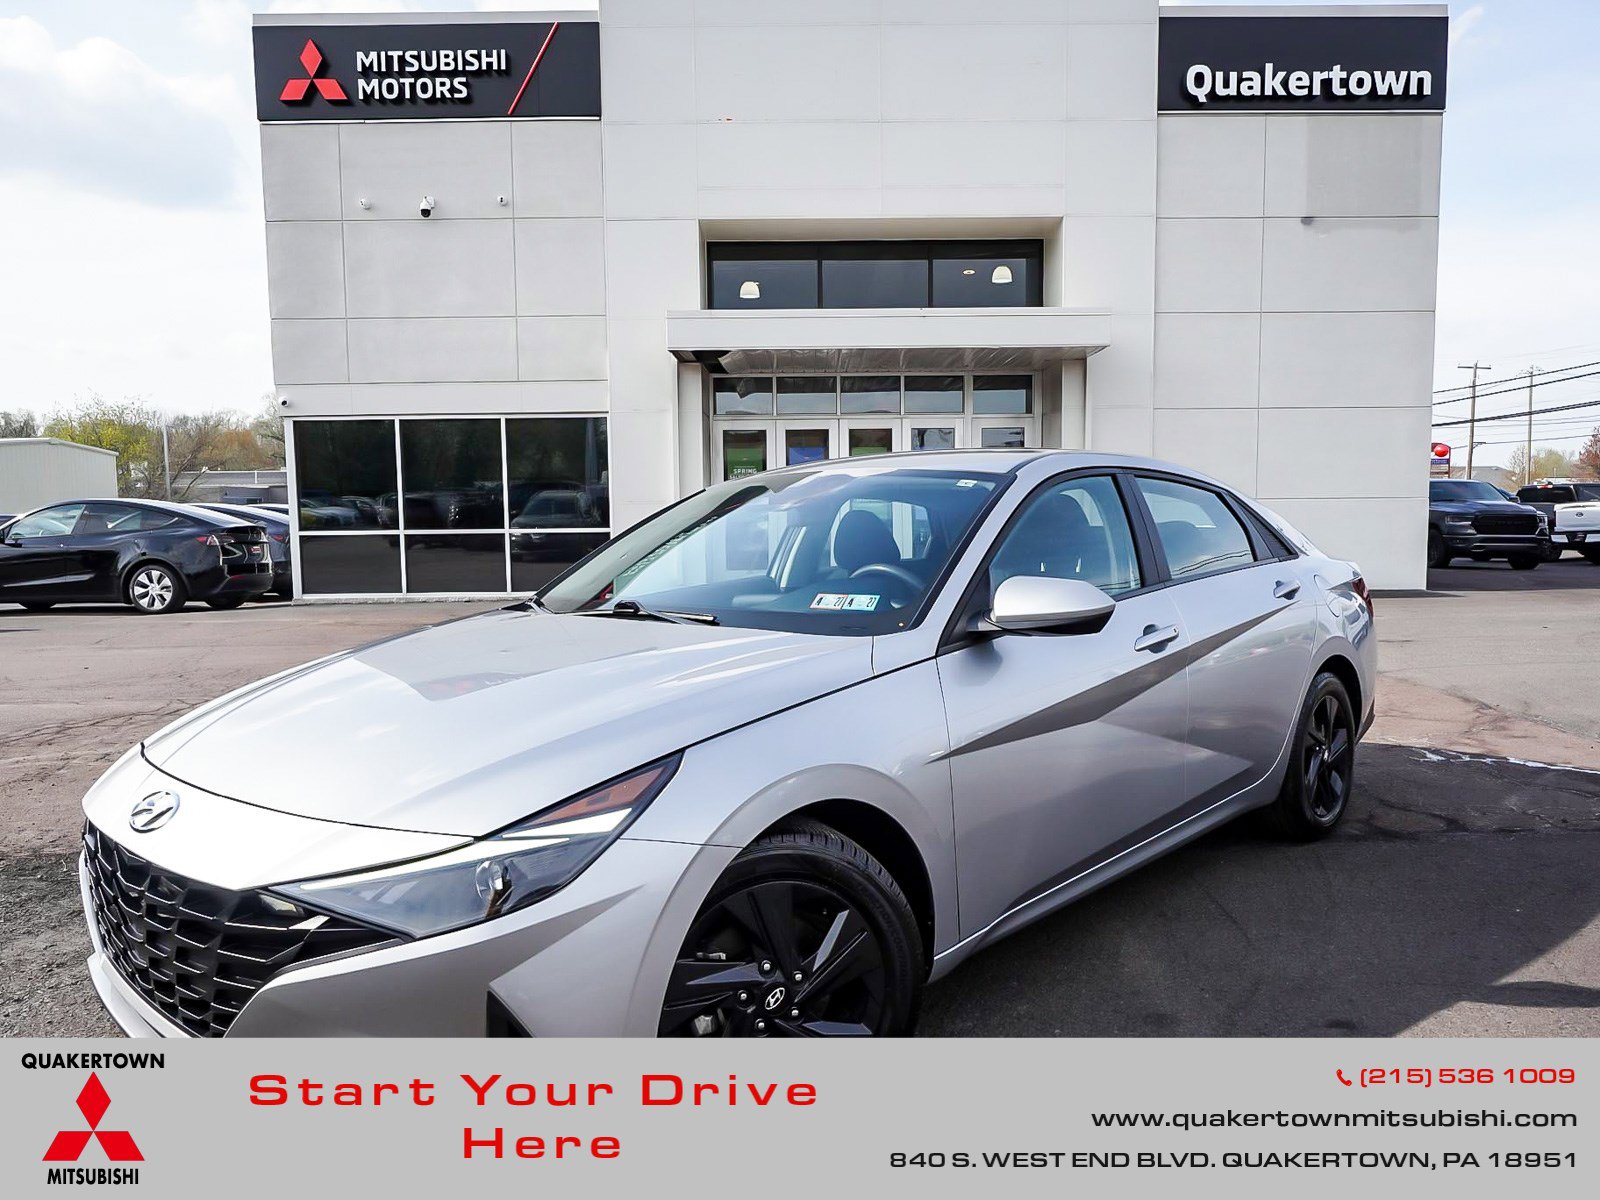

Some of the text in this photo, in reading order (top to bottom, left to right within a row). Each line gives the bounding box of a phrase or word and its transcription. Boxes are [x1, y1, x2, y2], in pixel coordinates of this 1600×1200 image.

[356, 49, 506, 72] MITSUBISHI
[358, 77, 468, 100] MOTORS
[1186, 63, 1432, 103] Quakertown
